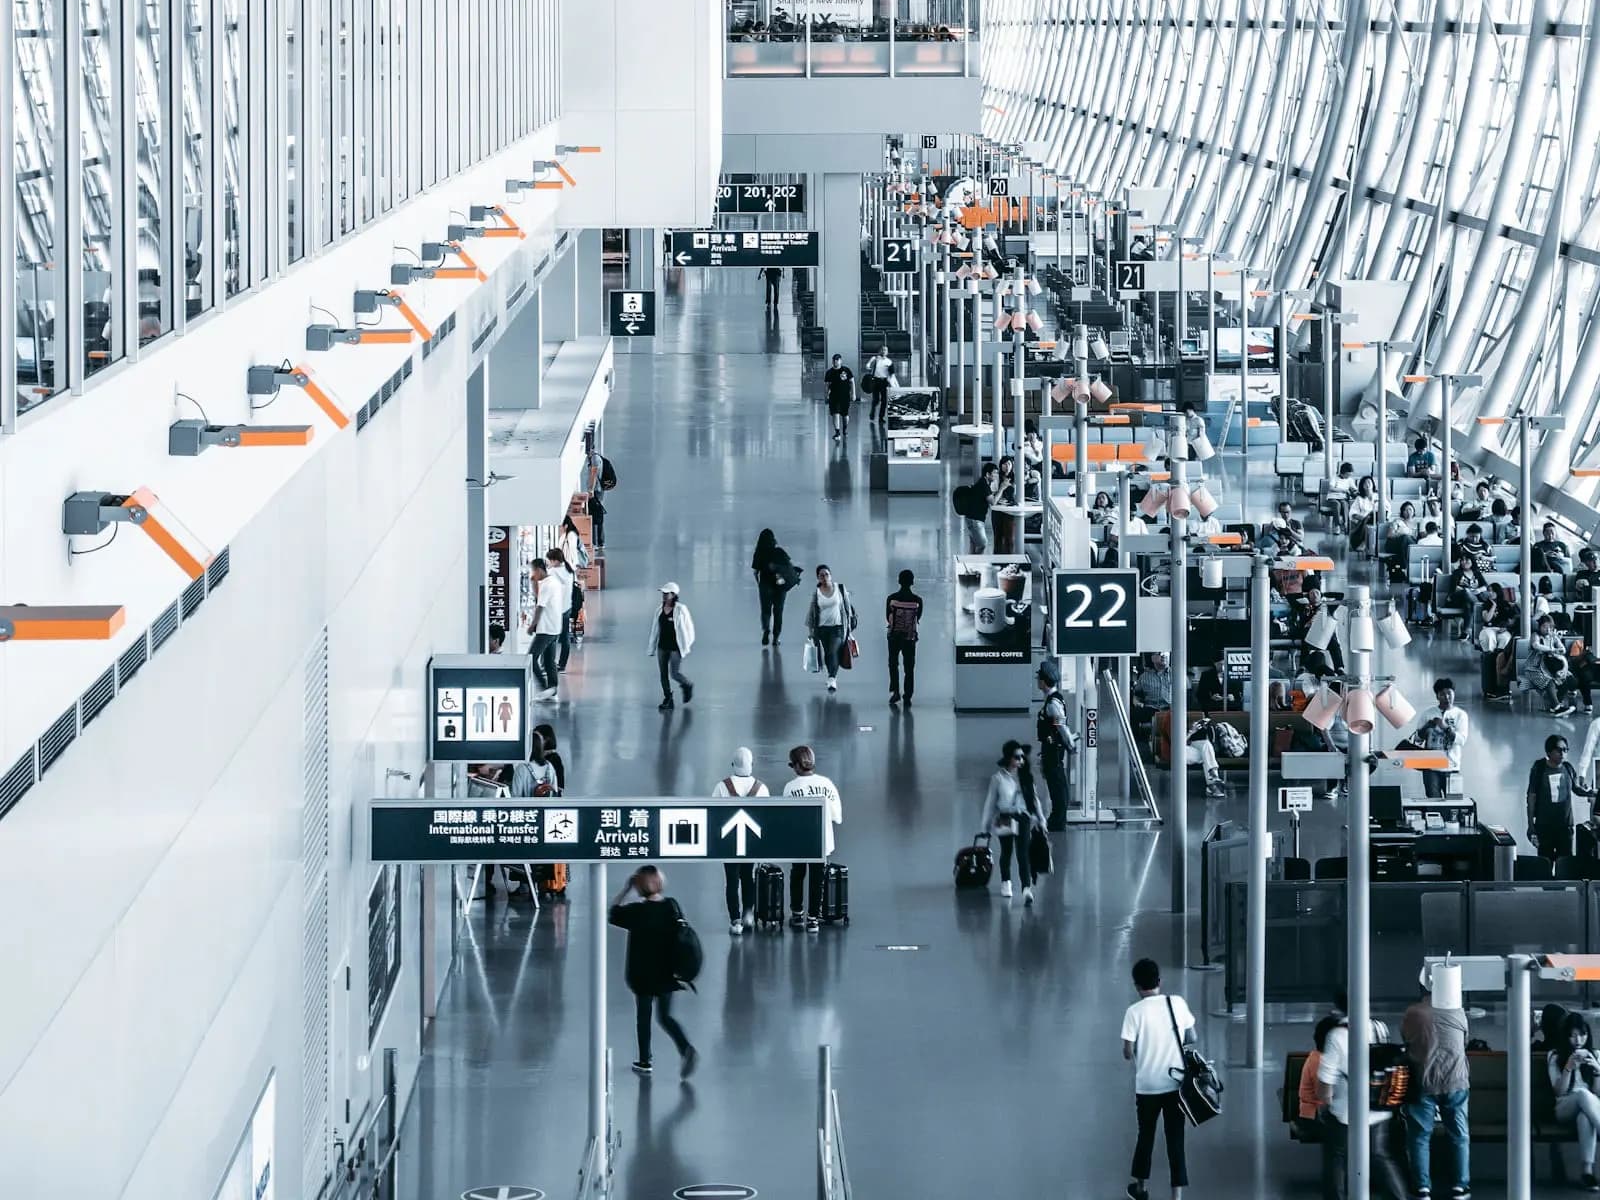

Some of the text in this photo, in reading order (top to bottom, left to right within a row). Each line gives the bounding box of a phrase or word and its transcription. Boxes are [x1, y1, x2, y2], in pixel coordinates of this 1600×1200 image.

[796, 13, 832, 25] KIX
[925, 136, 936, 148] 19
[992, 179, 1007, 195] 20
[887, 242, 912, 262] 21
[1124, 265, 1142, 289] 21
[1065, 583, 1128, 628] 22
[1088, 720, 1097, 746] AED
[433, 809, 539, 824] 国際線 乗り継ぎ
[429, 823, 539, 835] International Transfer
[594, 828, 650, 843] Arrivals
[599, 845, 622, 857] 到达
